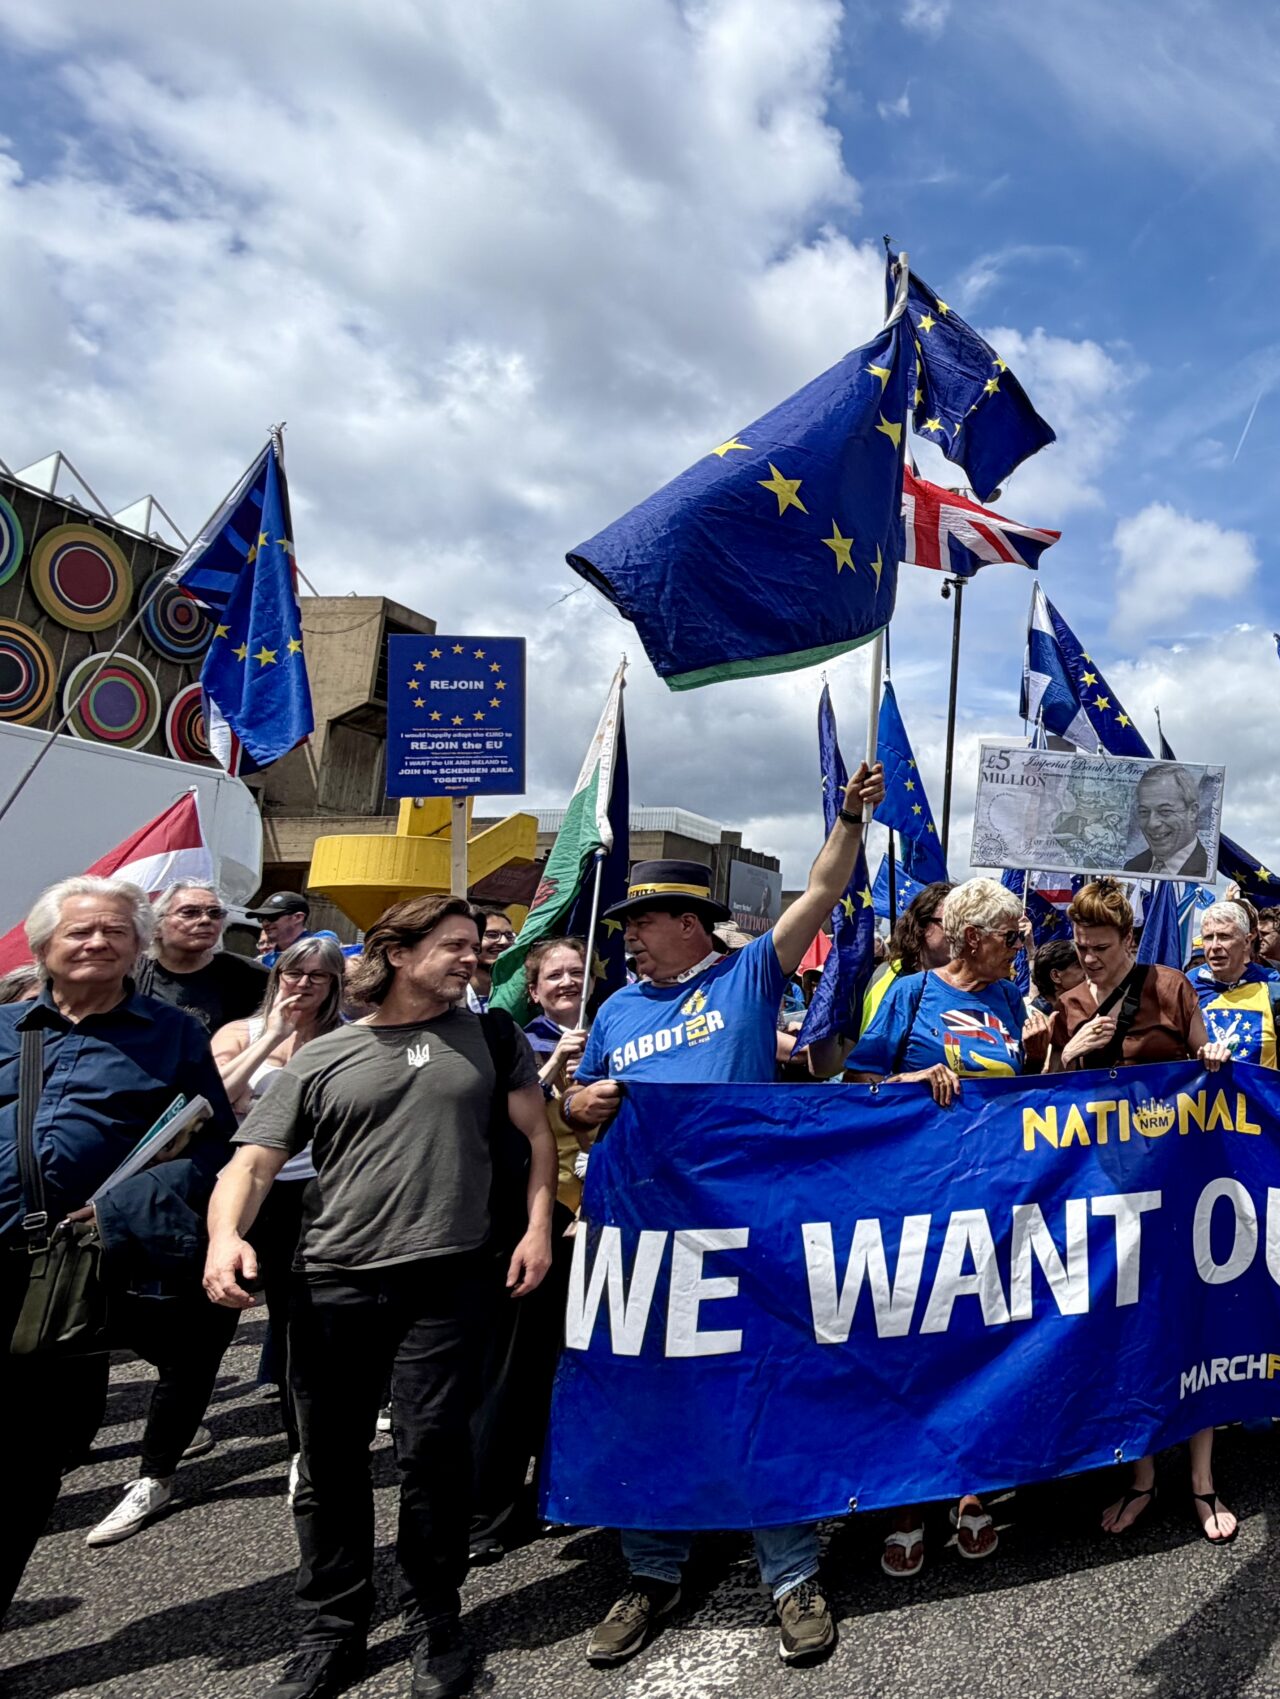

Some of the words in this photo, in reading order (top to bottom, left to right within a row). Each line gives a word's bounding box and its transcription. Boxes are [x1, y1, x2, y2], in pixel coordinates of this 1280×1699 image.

[430, 680, 484, 690] REJOIN
[410, 742, 458, 750] REJOIN
[486, 741, 503, 749] EU
[986, 750, 1011, 770] £5
[1118, 762, 1145, 775] Bre
[982, 772, 1046, 787] MILLION
[613, 1010, 724, 1072] SABOTEUR
[1022, 1088, 1262, 1151] NATIONAL
[1139, 1116, 1169, 1131] NRM
[564, 1221, 749, 1357] WE
[801, 1190, 1162, 1344] WANT
